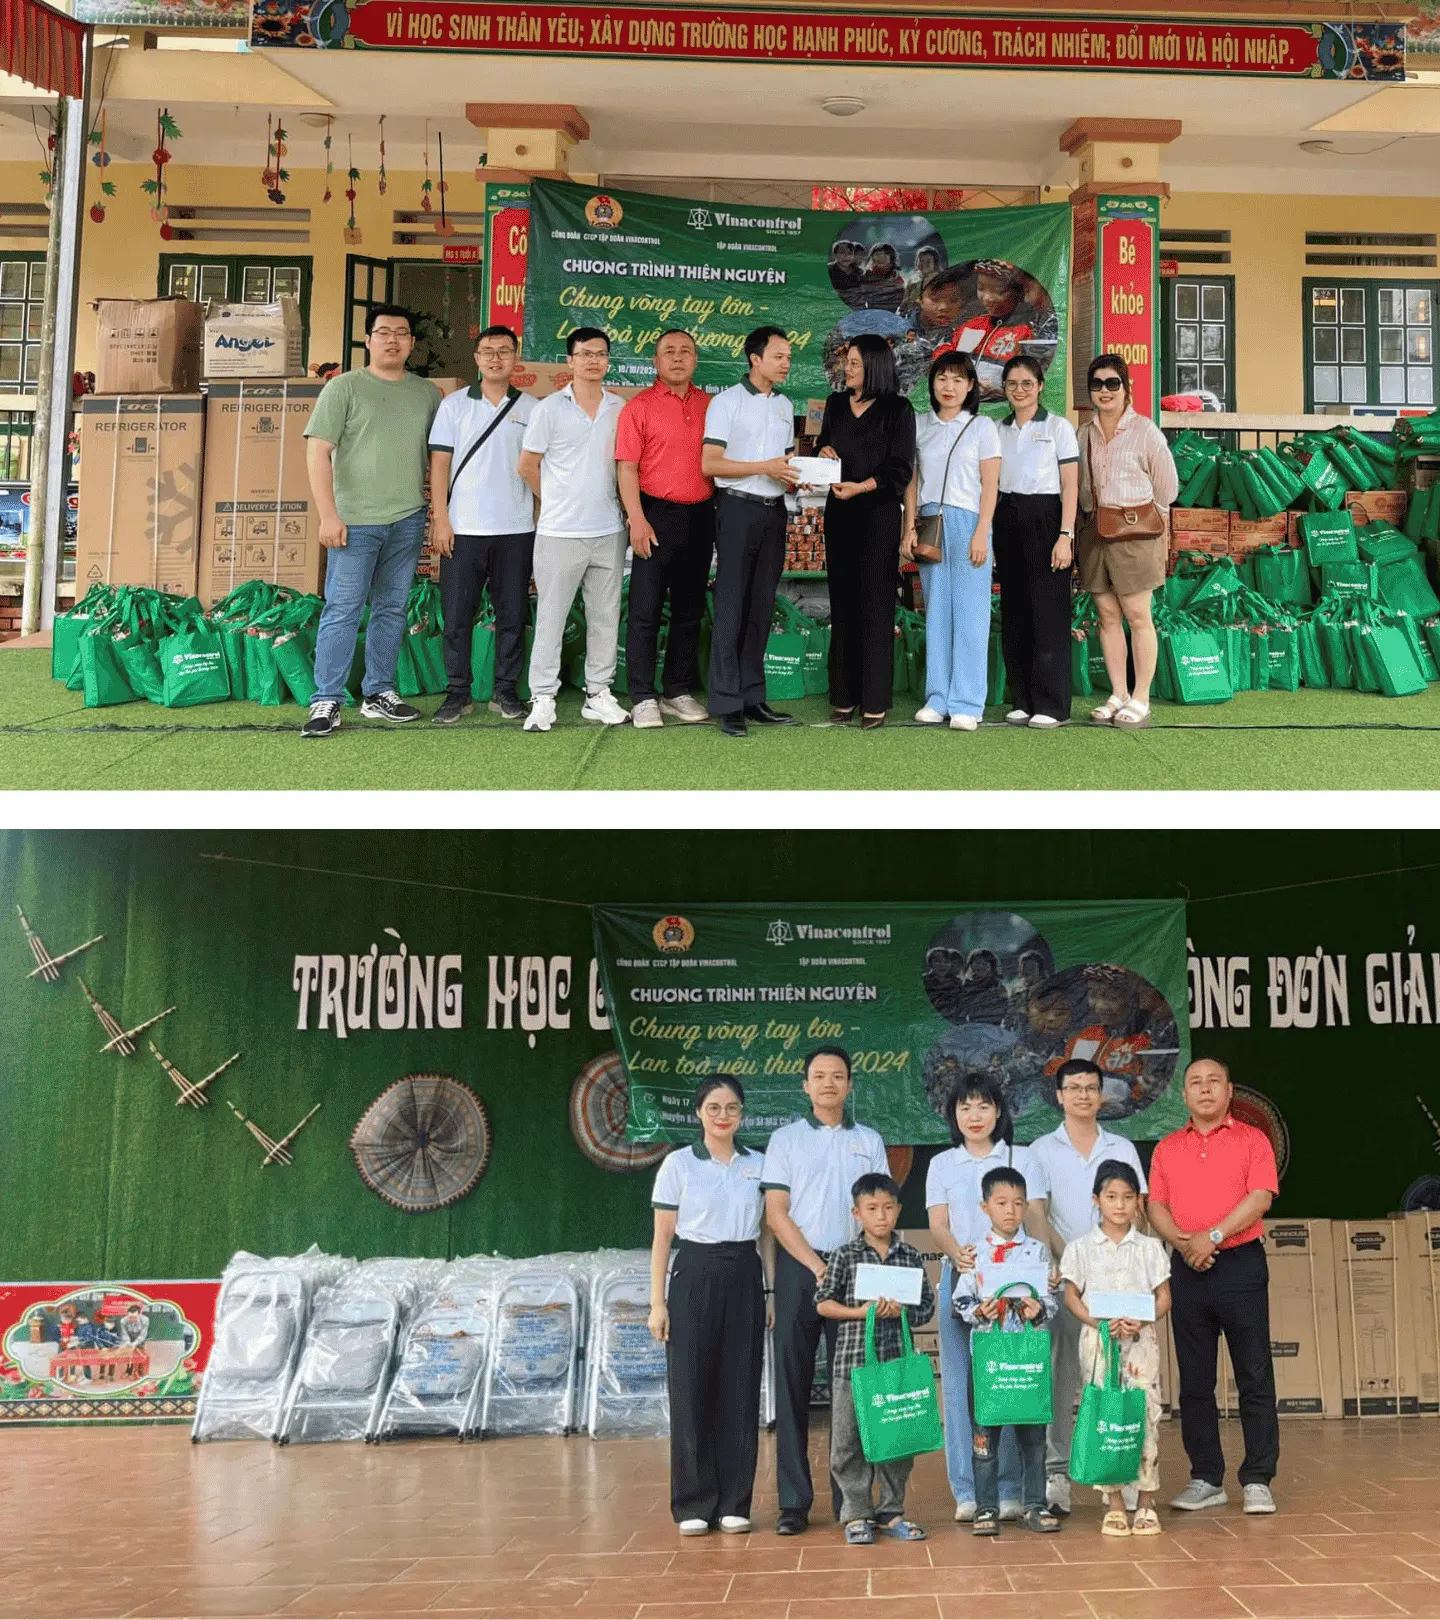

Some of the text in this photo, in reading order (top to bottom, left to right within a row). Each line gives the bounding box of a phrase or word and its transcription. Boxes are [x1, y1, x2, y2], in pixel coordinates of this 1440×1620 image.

[387, 8, 1295, 71] VÌ HỌC SINH THÂN YÊU; XÂY DỰNG TRƯỜNG HỌC HẠNH PHÚC, KỶ CƯƠNG, TRÁCH NHIỆM; ĐỔI MỚI VÀ HỘI NHẬP.
[715, 213, 802, 230] Vinacontrol
[1119, 235, 1136, 265] Bé
[562, 258, 786, 285] CHƯƠNG TRÌNH THIỆN NGUYỆN
[559, 286, 625, 319] Chung
[629, 294, 677, 322] vòng
[681, 295, 716, 324] tay
[719, 294, 754, 317] lớn
[1111, 282, 1144, 315] khỏe
[635, 327, 662, 354] yê
[796, 924, 891, 939] Vinacontrol
[292, 927, 464, 1039] TRƯỜNG
[486, 955, 572, 1049] HỌC
[630, 982, 877, 1005] CHƯƠNG TRÌNH THIỆN NGUYỆN
[1267, 945, 1351, 1029] ĐƠN
[629, 1016, 701, 1050] Chung
[707, 1019, 759, 1050] vòng
[765, 1019, 801, 1050] tay
[807, 1016, 844, 1039] lớn
[627, 1050, 670, 1073] Lan
[764, 1052, 806, 1075] thư
[851, 1051, 910, 1073] 2024
